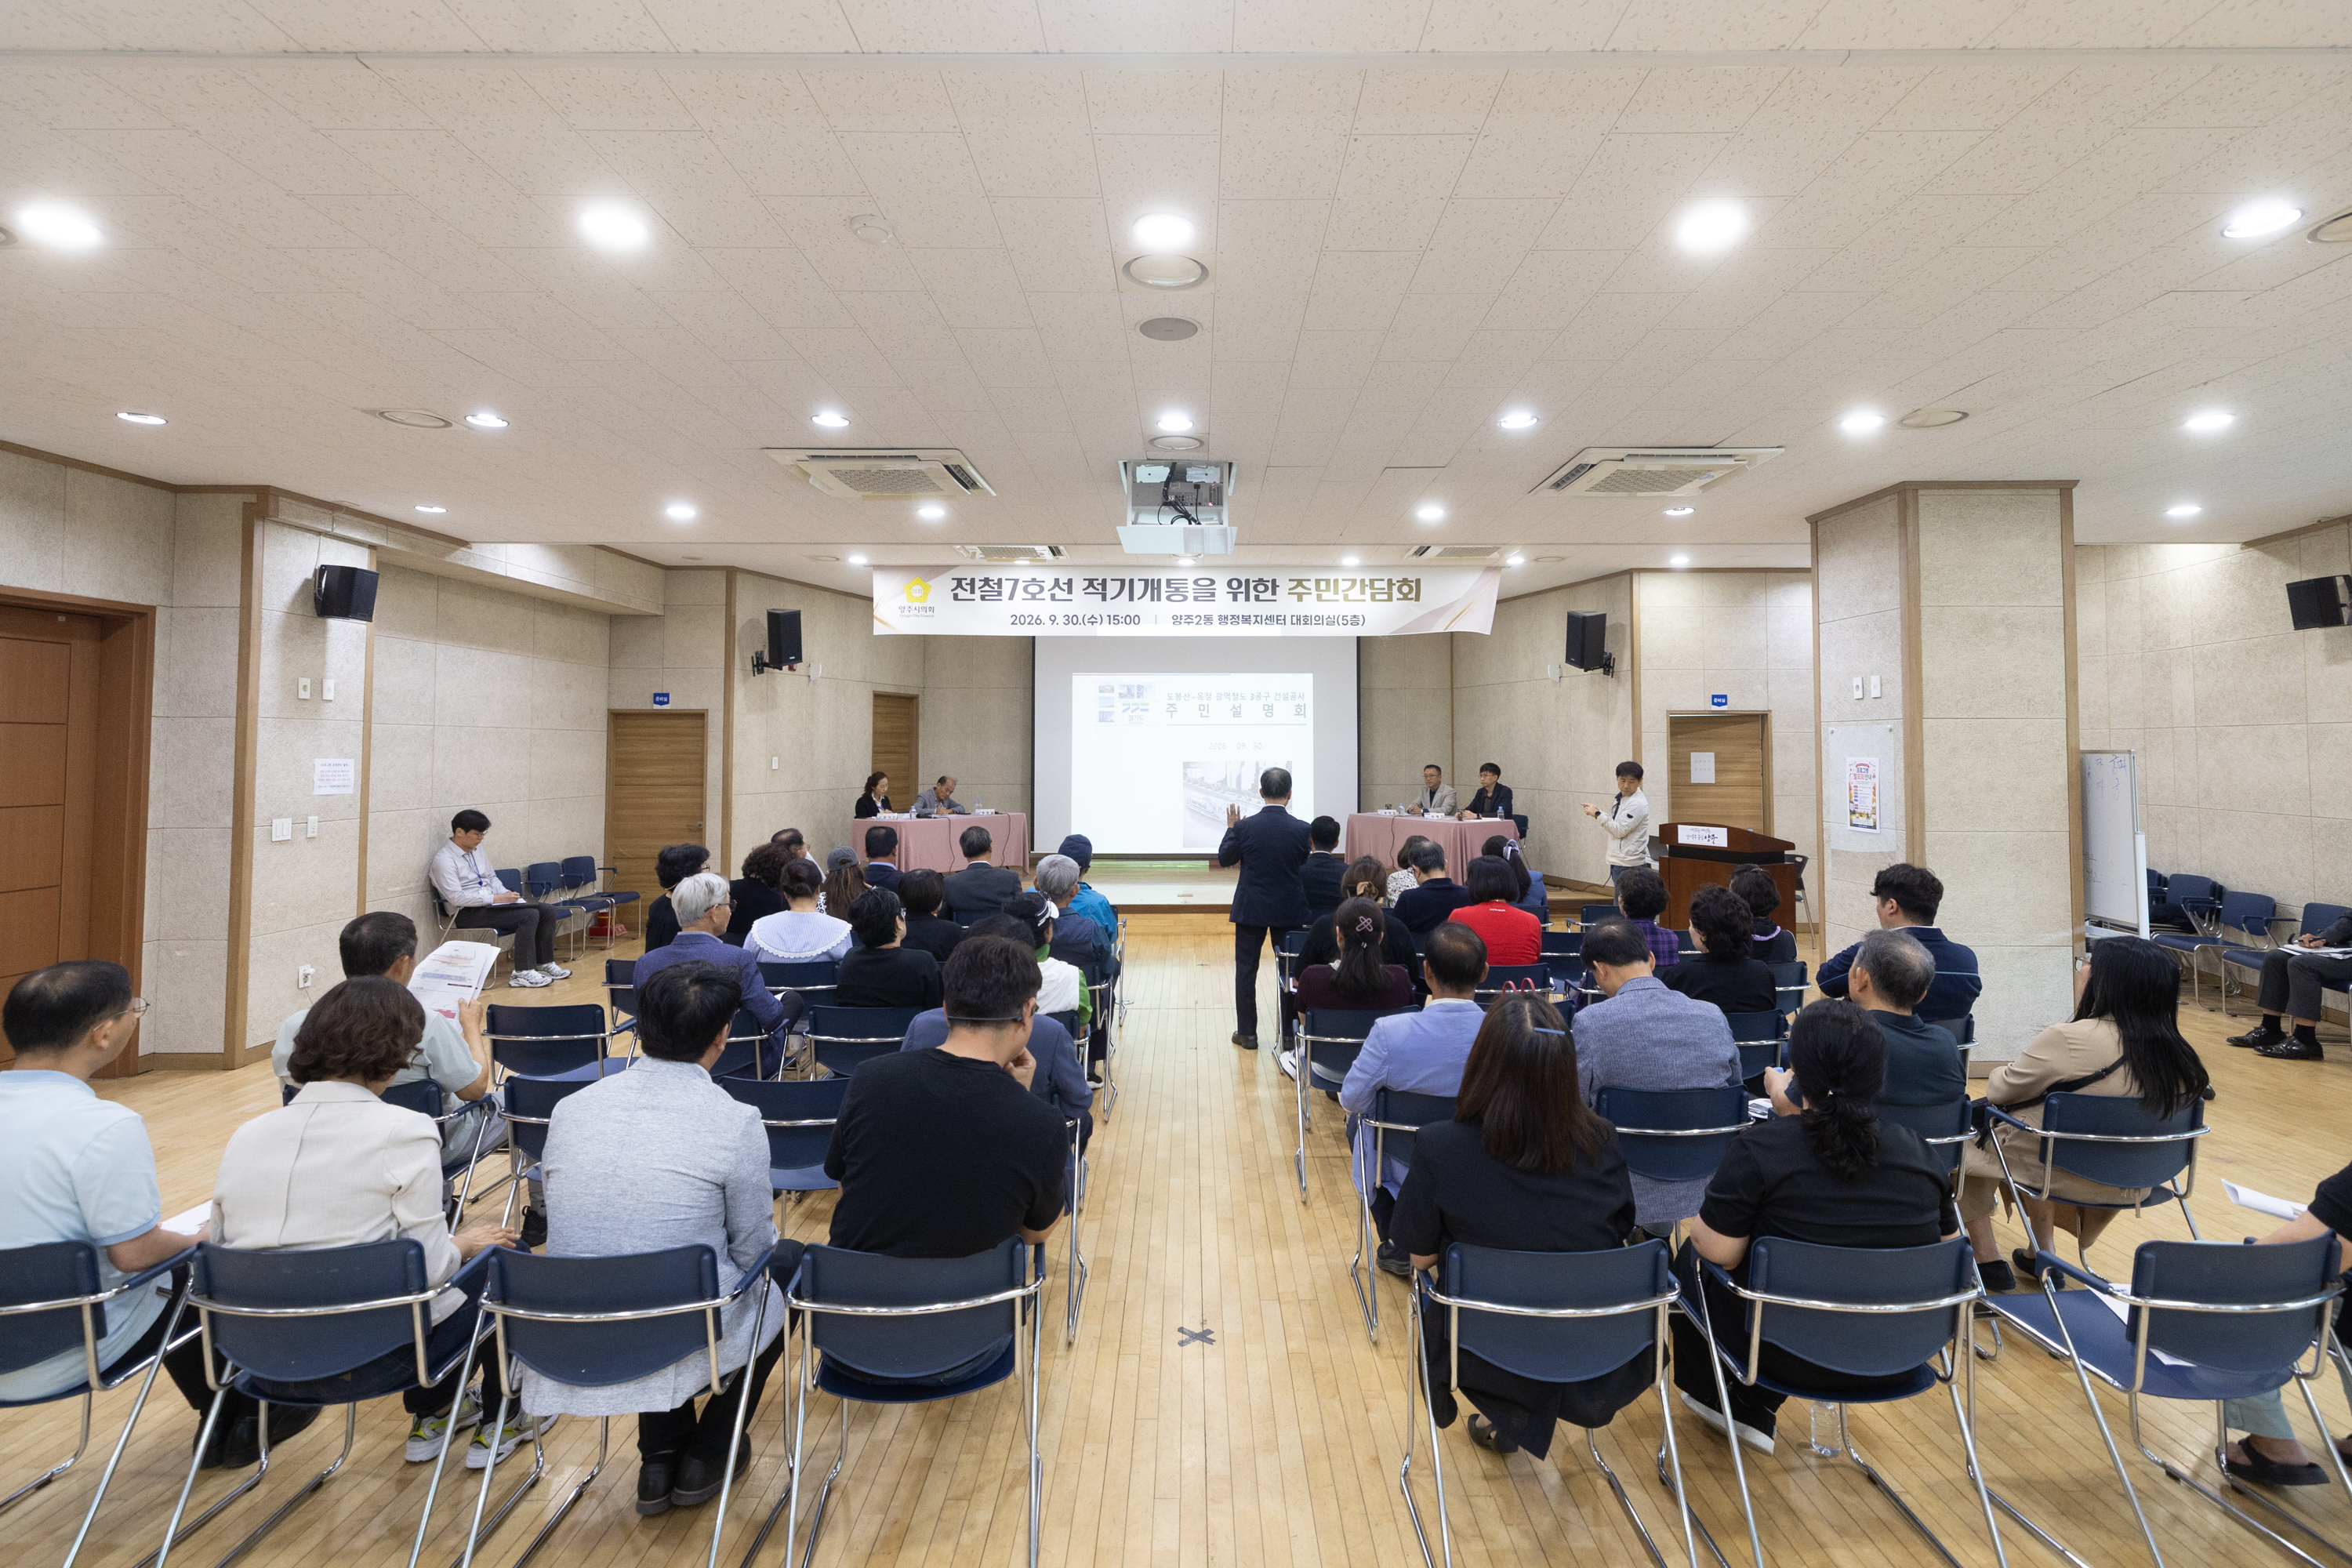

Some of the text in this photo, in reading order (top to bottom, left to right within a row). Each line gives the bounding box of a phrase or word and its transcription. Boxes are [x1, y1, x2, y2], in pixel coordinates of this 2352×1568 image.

[950, 576, 1421, 603] 전철7호선 적기개통을 위한 주민간담회
[898, 605, 935, 614] 양주시의회
[1010, 614, 1366, 626] 2026. 9. 30.(수) 15:00 양주2동 행정복지센터 대회의실(5층)
[1167, 691, 1305, 702] 도봉산~옥정 광역철도 3공구 건설공사
[1704, 833, 1719, 844] 양주
